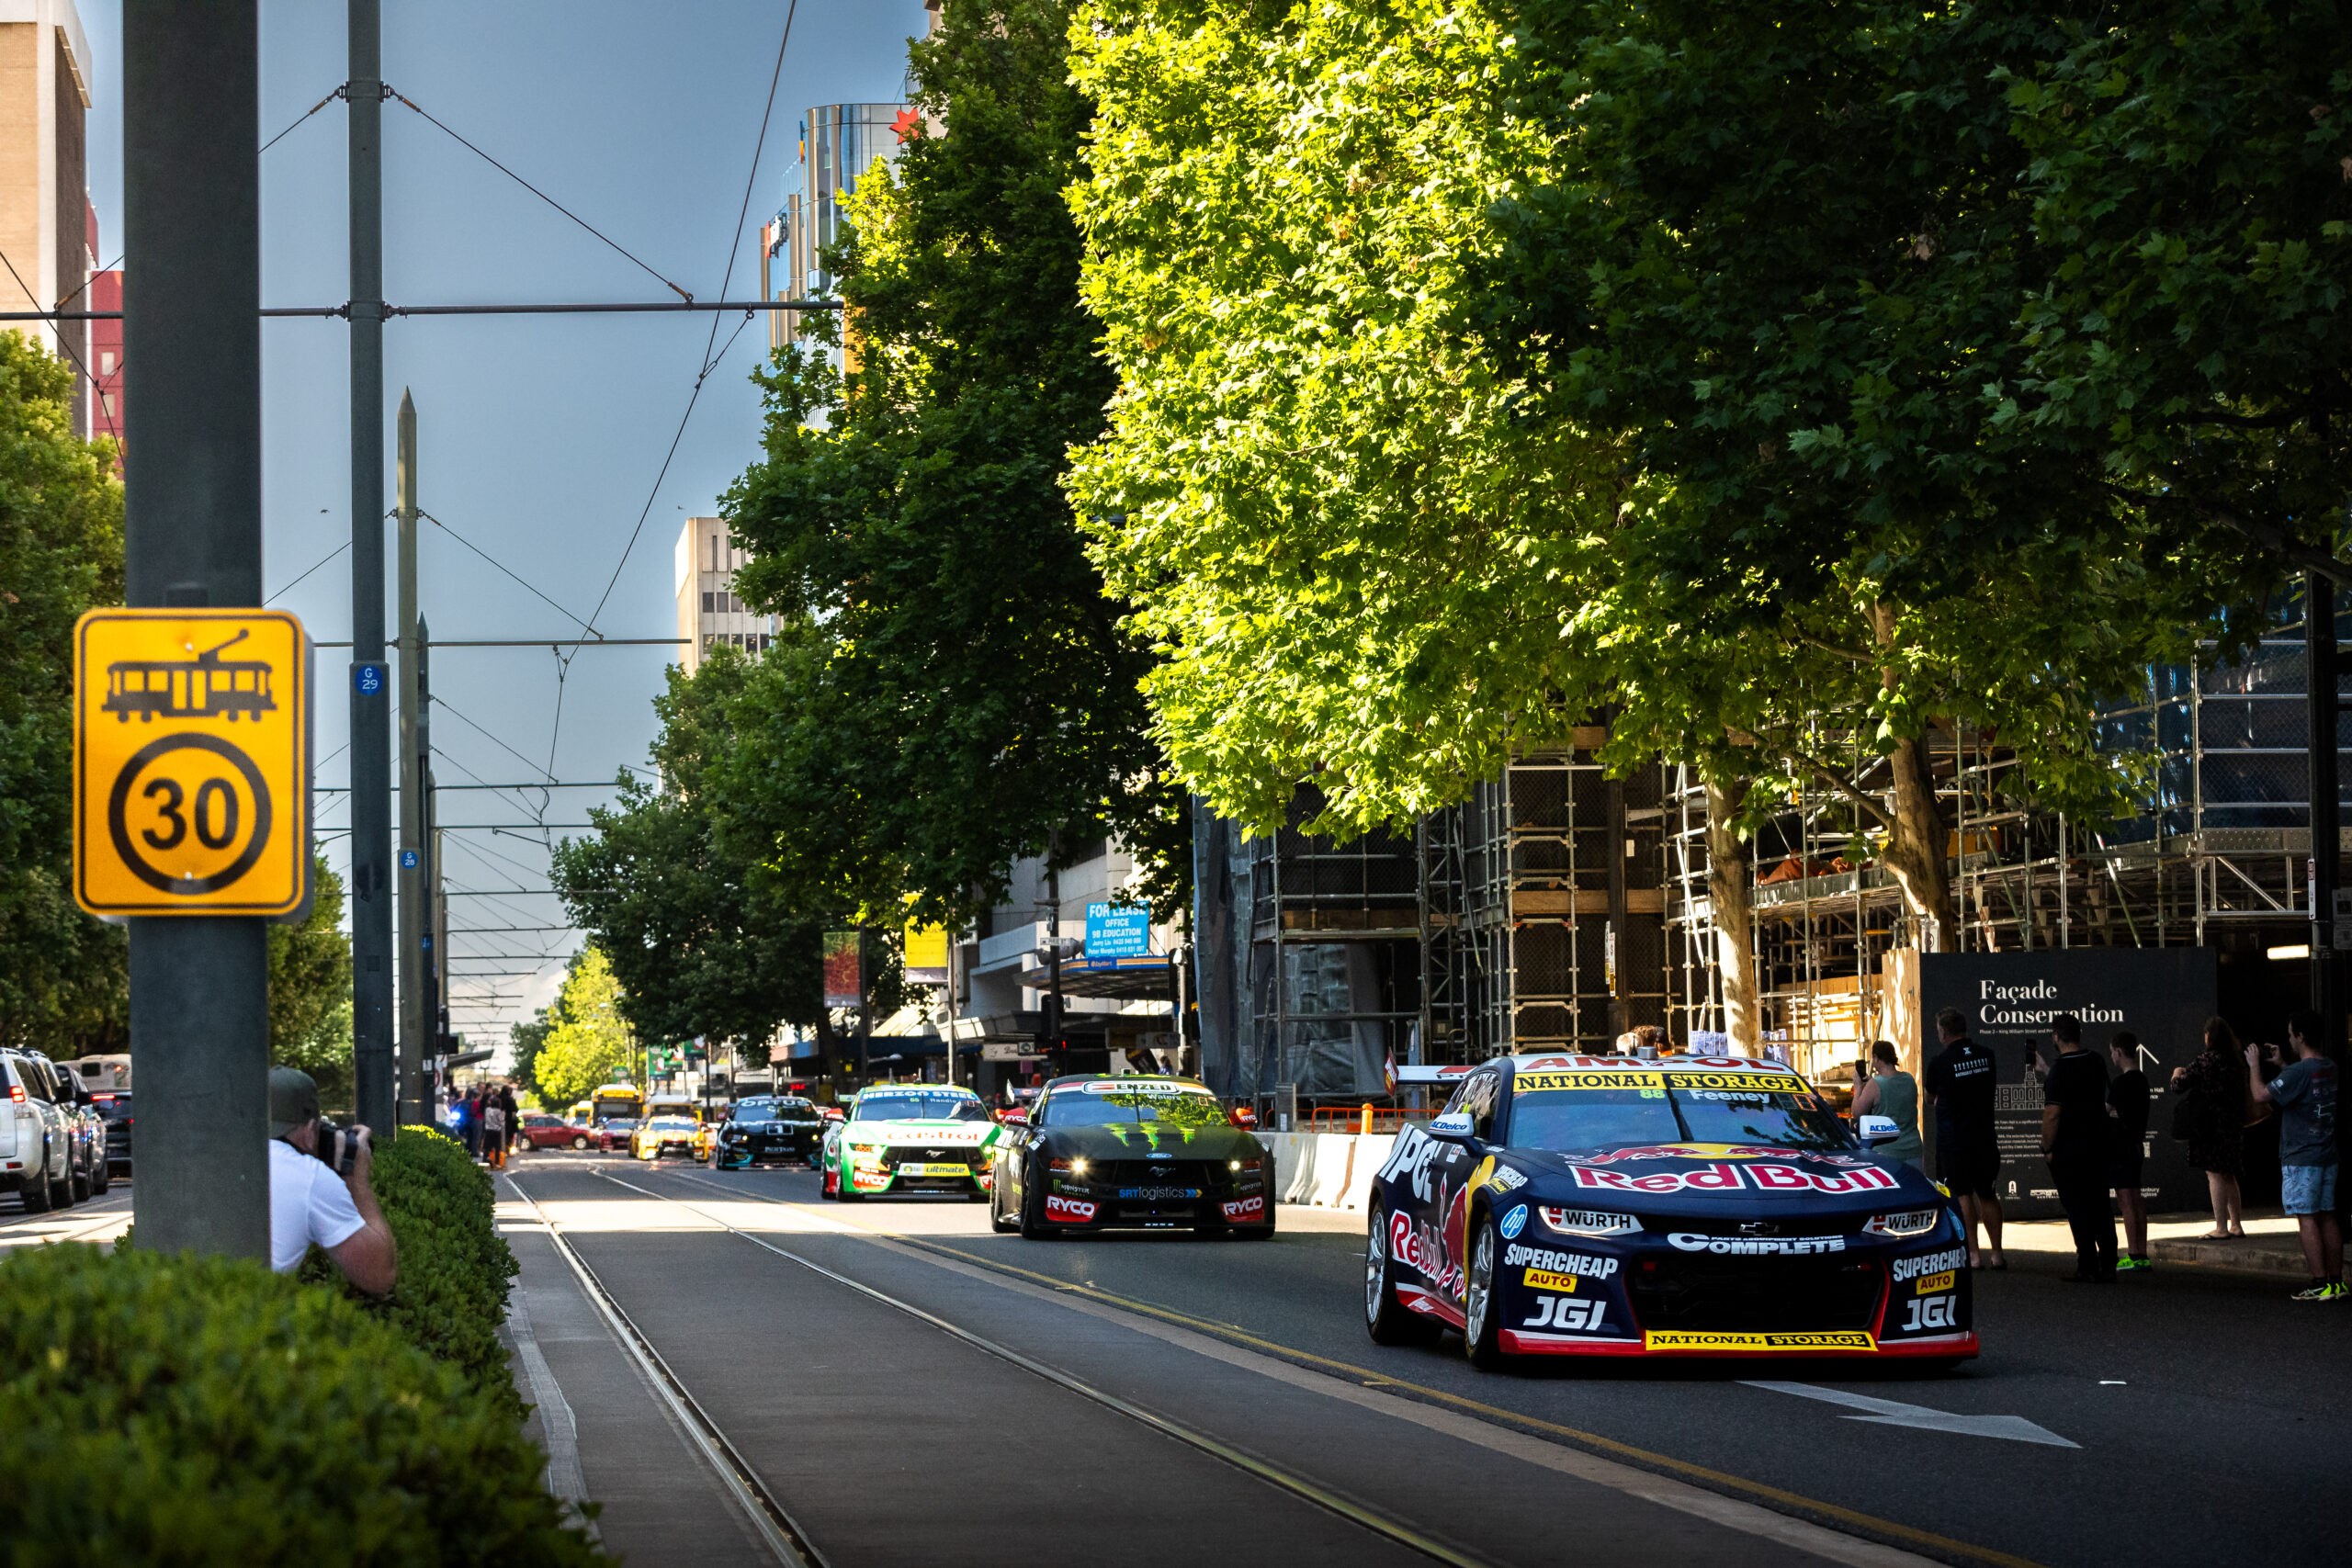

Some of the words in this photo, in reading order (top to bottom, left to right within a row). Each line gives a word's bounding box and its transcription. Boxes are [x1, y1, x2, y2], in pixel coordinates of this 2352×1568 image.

[364, 668, 373, 678] G
[362, 680, 379, 690] 29
[141, 776, 239, 851] 30
[1089, 904, 1111, 919] FOR
[1104, 918, 1130, 928] OFFICE
[1102, 928, 1142, 938] EDUCATION
[1979, 979, 2058, 1005] Façade
[1980, 1002, 2125, 1024] Conseration
[1116, 1083, 1171, 1091] ENZED
[1518, 1074, 1657, 1089] NATIONAL
[1672, 1074, 1798, 1092] STORAGE
[927, 1090, 976, 1100] STEEL
[1639, 1089, 1666, 1100] 88
[1690, 1089, 1770, 1104] Feeney
[741, 1100, 810, 1108] OPTUS
[775, 1124, 784, 1134] 1
[1430, 1120, 1468, 1131] ACDelco
[887, 1131, 978, 1141] Castrol
[926, 1164, 966, 1174] ultimate
[854, 1171, 890, 1186] RYCO
[1567, 1163, 1747, 1193] Red
[1741, 1163, 1901, 1194] Bull
[1046, 1195, 1095, 1217] RYCO
[1223, 1196, 1263, 1216] RYCO
[1504, 1205, 1525, 1237] hp
[1566, 1211, 1632, 1229] WÜRTH
[1888, 1211, 1935, 1230] WÜRTH
[1667, 1233, 1846, 1255] COMPLETE
[1504, 1243, 1619, 1280] SUPERCHEAP
[1528, 1272, 1571, 1288] AUTO
[1920, 1276, 1951, 1290] AUTO
[1522, 1295, 1608, 1331] JGI
[1901, 1295, 1957, 1332] JGI
[1651, 1335, 1762, 1346] NATIONAL
[1773, 1335, 1868, 1346] STORAGE
